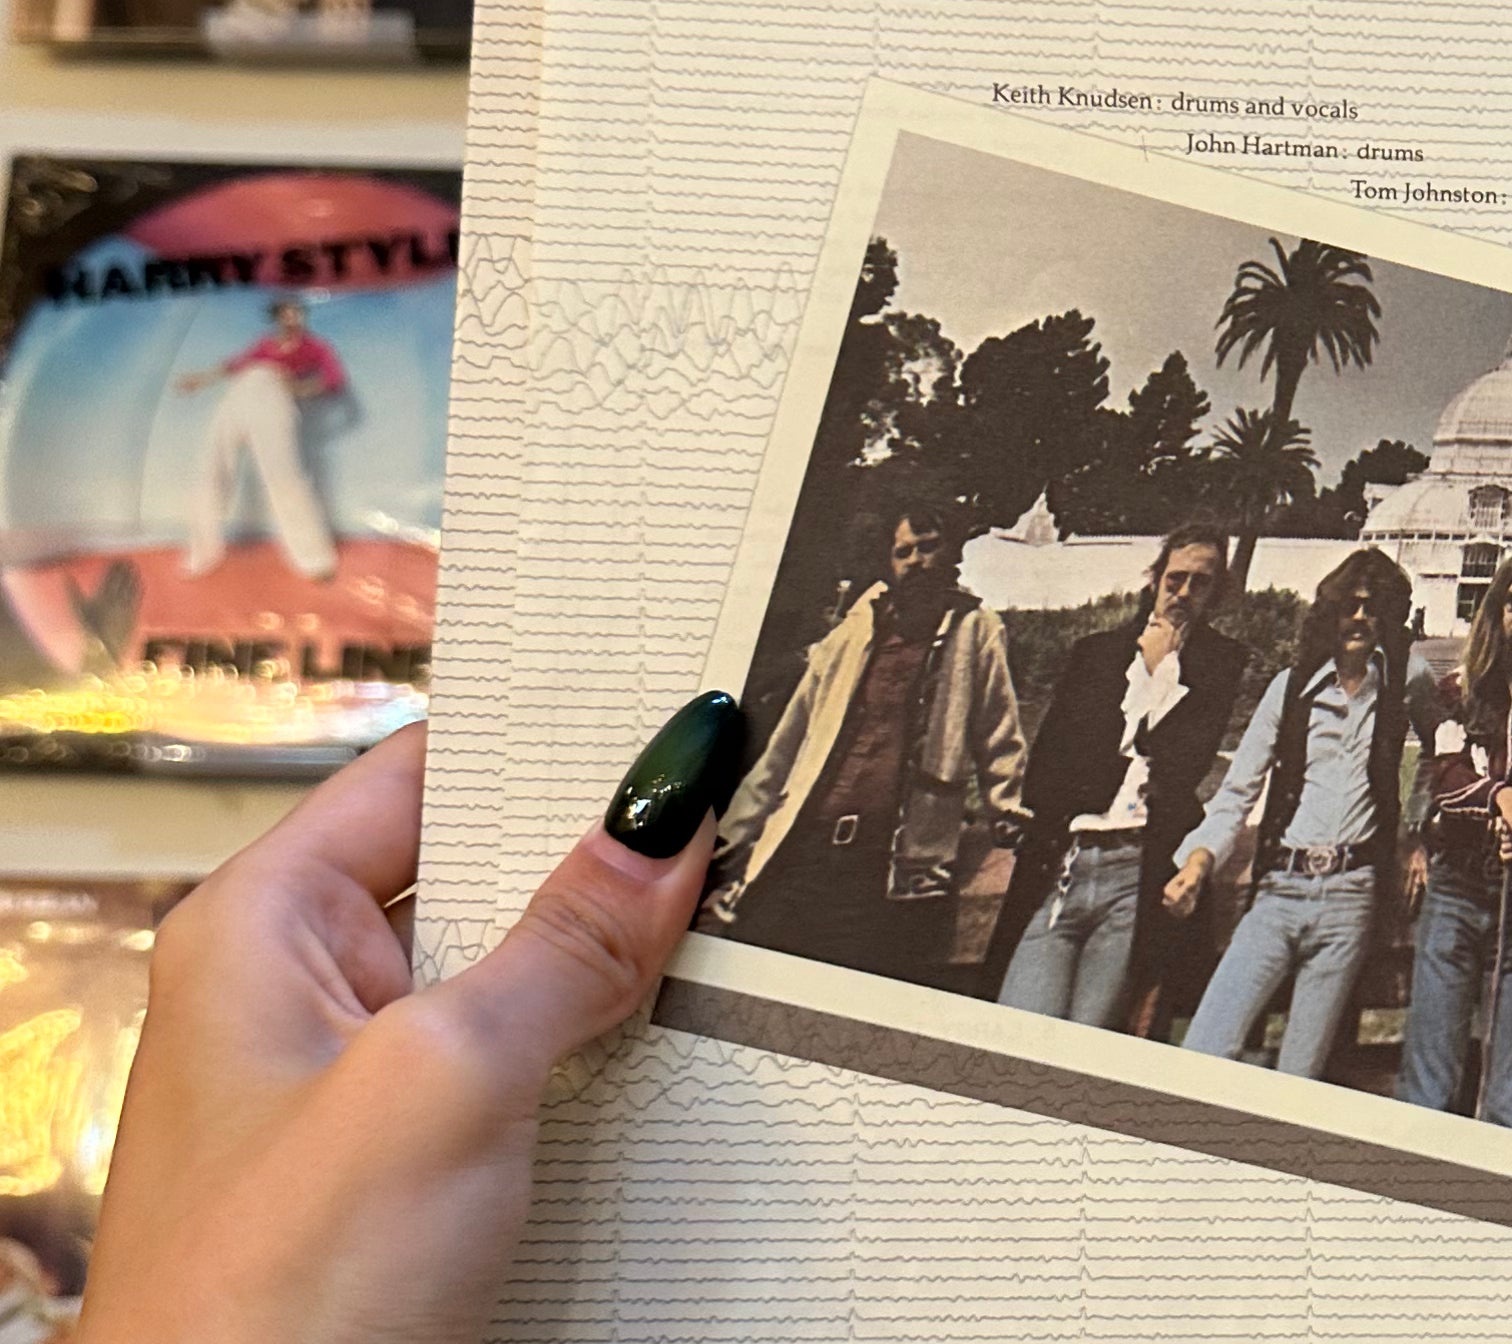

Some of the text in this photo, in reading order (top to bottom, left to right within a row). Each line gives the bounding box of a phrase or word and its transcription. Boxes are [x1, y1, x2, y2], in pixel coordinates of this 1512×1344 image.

[991, 84, 1358, 119] Keith Knudsen: drums and vocals
[1185, 135, 1424, 163] John Hartman: drums
[1350, 179, 1398, 201] Tom
[1404, 181, 1507, 205] Johnston:
